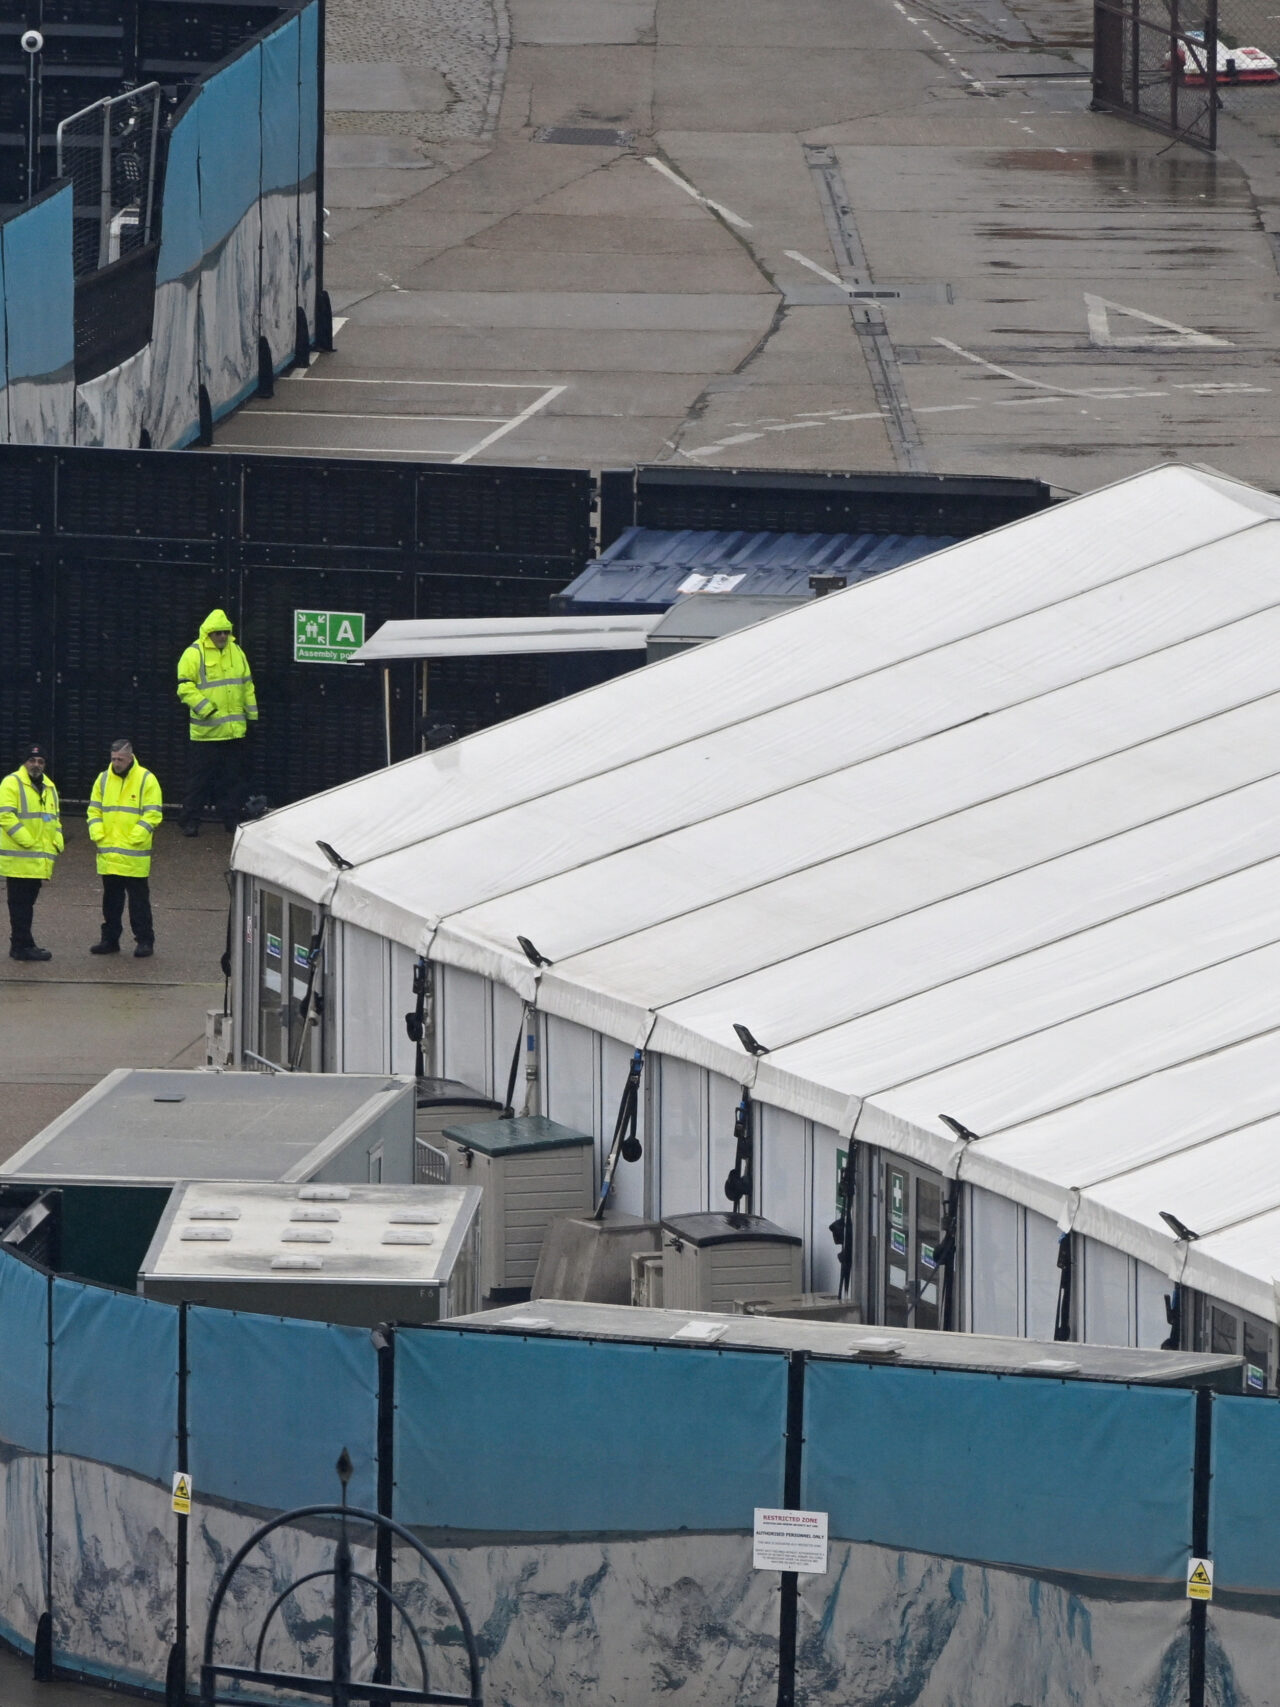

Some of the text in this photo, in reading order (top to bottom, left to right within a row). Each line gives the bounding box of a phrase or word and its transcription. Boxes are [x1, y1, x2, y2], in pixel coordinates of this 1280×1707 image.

[763, 1514, 818, 1524] RESTRICTED ZONE
[336, 1620, 355, 1642] A
[299, 1649, 338, 1660] Assembly
